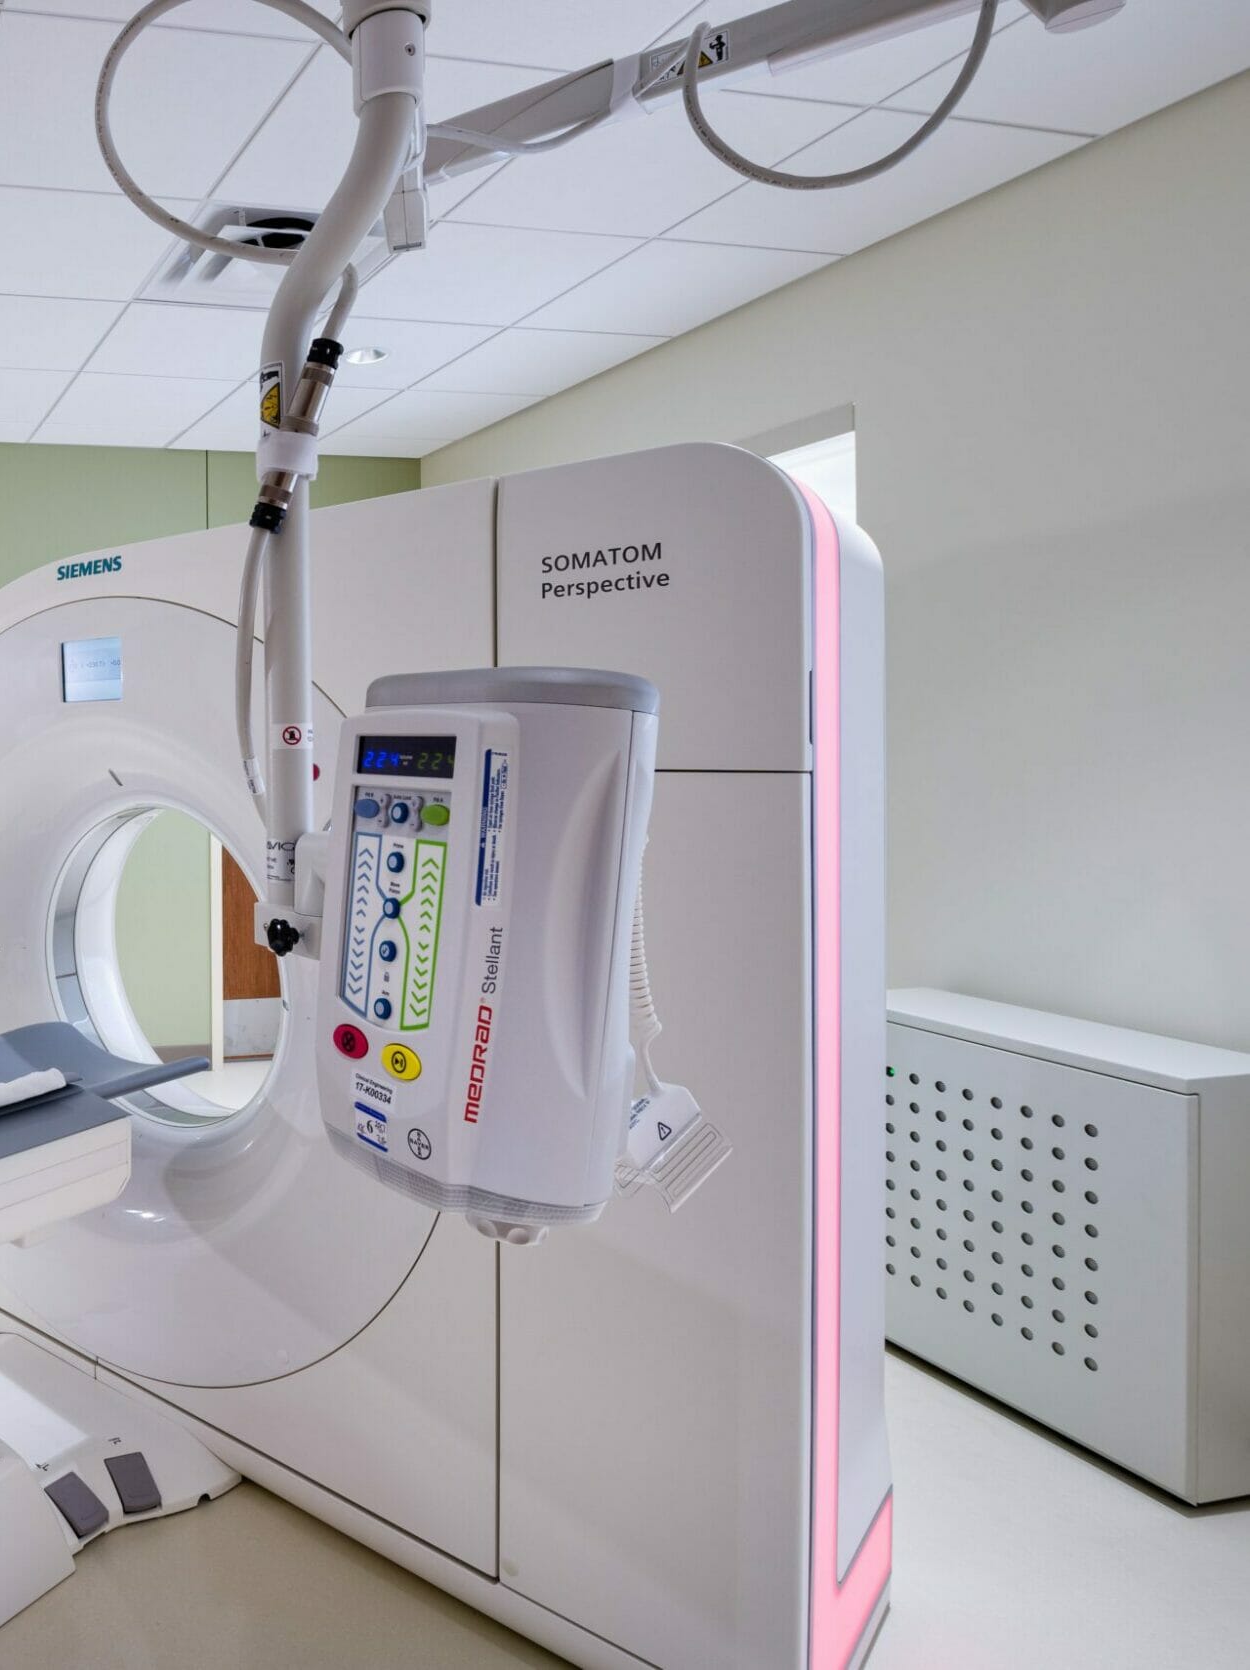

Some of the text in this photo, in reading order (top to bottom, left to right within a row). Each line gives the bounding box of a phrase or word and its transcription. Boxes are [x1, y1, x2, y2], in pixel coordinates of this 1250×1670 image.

[56, 555, 122, 581] SIEMENS
[541, 542, 662, 574] SOMATOM
[541, 571, 670, 599] Perspective
[363, 752, 400, 768] 224
[481, 926, 503, 994] Stellant
[355, 1081, 392, 1104] 17-K00334
